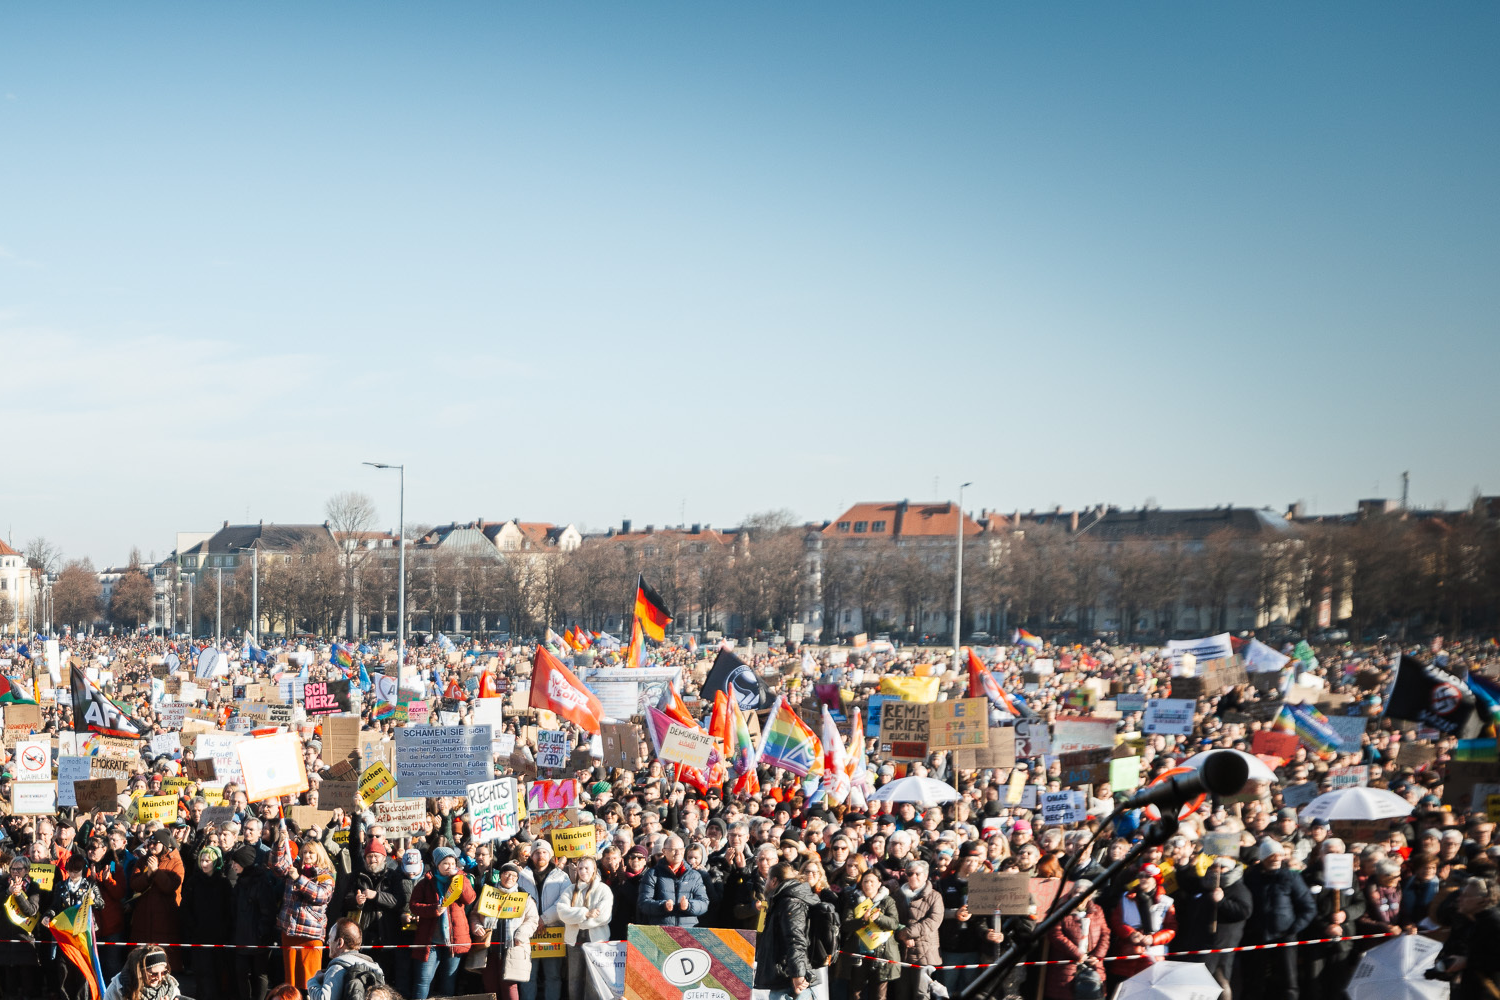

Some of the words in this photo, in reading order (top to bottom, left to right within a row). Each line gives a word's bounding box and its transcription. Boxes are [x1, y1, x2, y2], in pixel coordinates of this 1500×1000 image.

[304, 683, 327, 696] SCH
[306, 694, 339, 709] MERZ.
[884, 704, 927, 719] REMI-
[933, 703, 978, 720] BIER
[403, 727, 447, 738] SCHÄMEN
[450, 728, 464, 736] SIE
[669, 726, 710, 745] DEMOKRATIE
[889, 733, 910, 741] EUCH
[914, 733, 928, 742] INS
[934, 731, 984, 746] HETZE
[209, 750, 234, 758] Frauen
[91, 757, 129, 771] EMOKRATIE
[397, 761, 449, 769] Schutzsuchende
[440, 769, 460, 777] haben
[370, 777, 389, 794] bunt!
[469, 782, 510, 806] RECHTS
[528, 778, 577, 809] 161
[1046, 794, 1068, 802] OMAS
[141, 799, 175, 809] München
[474, 806, 491, 816] wird
[494, 801, 509, 811] nur
[1045, 803, 1071, 812] GEGEN
[143, 811, 153, 819] ist
[154, 809, 174, 819] bunt!
[377, 813, 392, 823] AfD
[392, 812, 415, 822] wählen
[1044, 811, 1075, 822] RECHTS
[472, 812, 516, 839] GESTRICKT
[555, 830, 592, 841] München
[557, 844, 568, 852] ist
[569, 841, 592, 852] bunt!
[486, 889, 524, 903] München
[485, 902, 496, 911] ist
[530, 930, 562, 940] ünchen
[538, 942, 561, 952] bunt!
[680, 957, 695, 976] D
[686, 992, 709, 1000] STEHT
[711, 991, 726, 1000] FÜR
